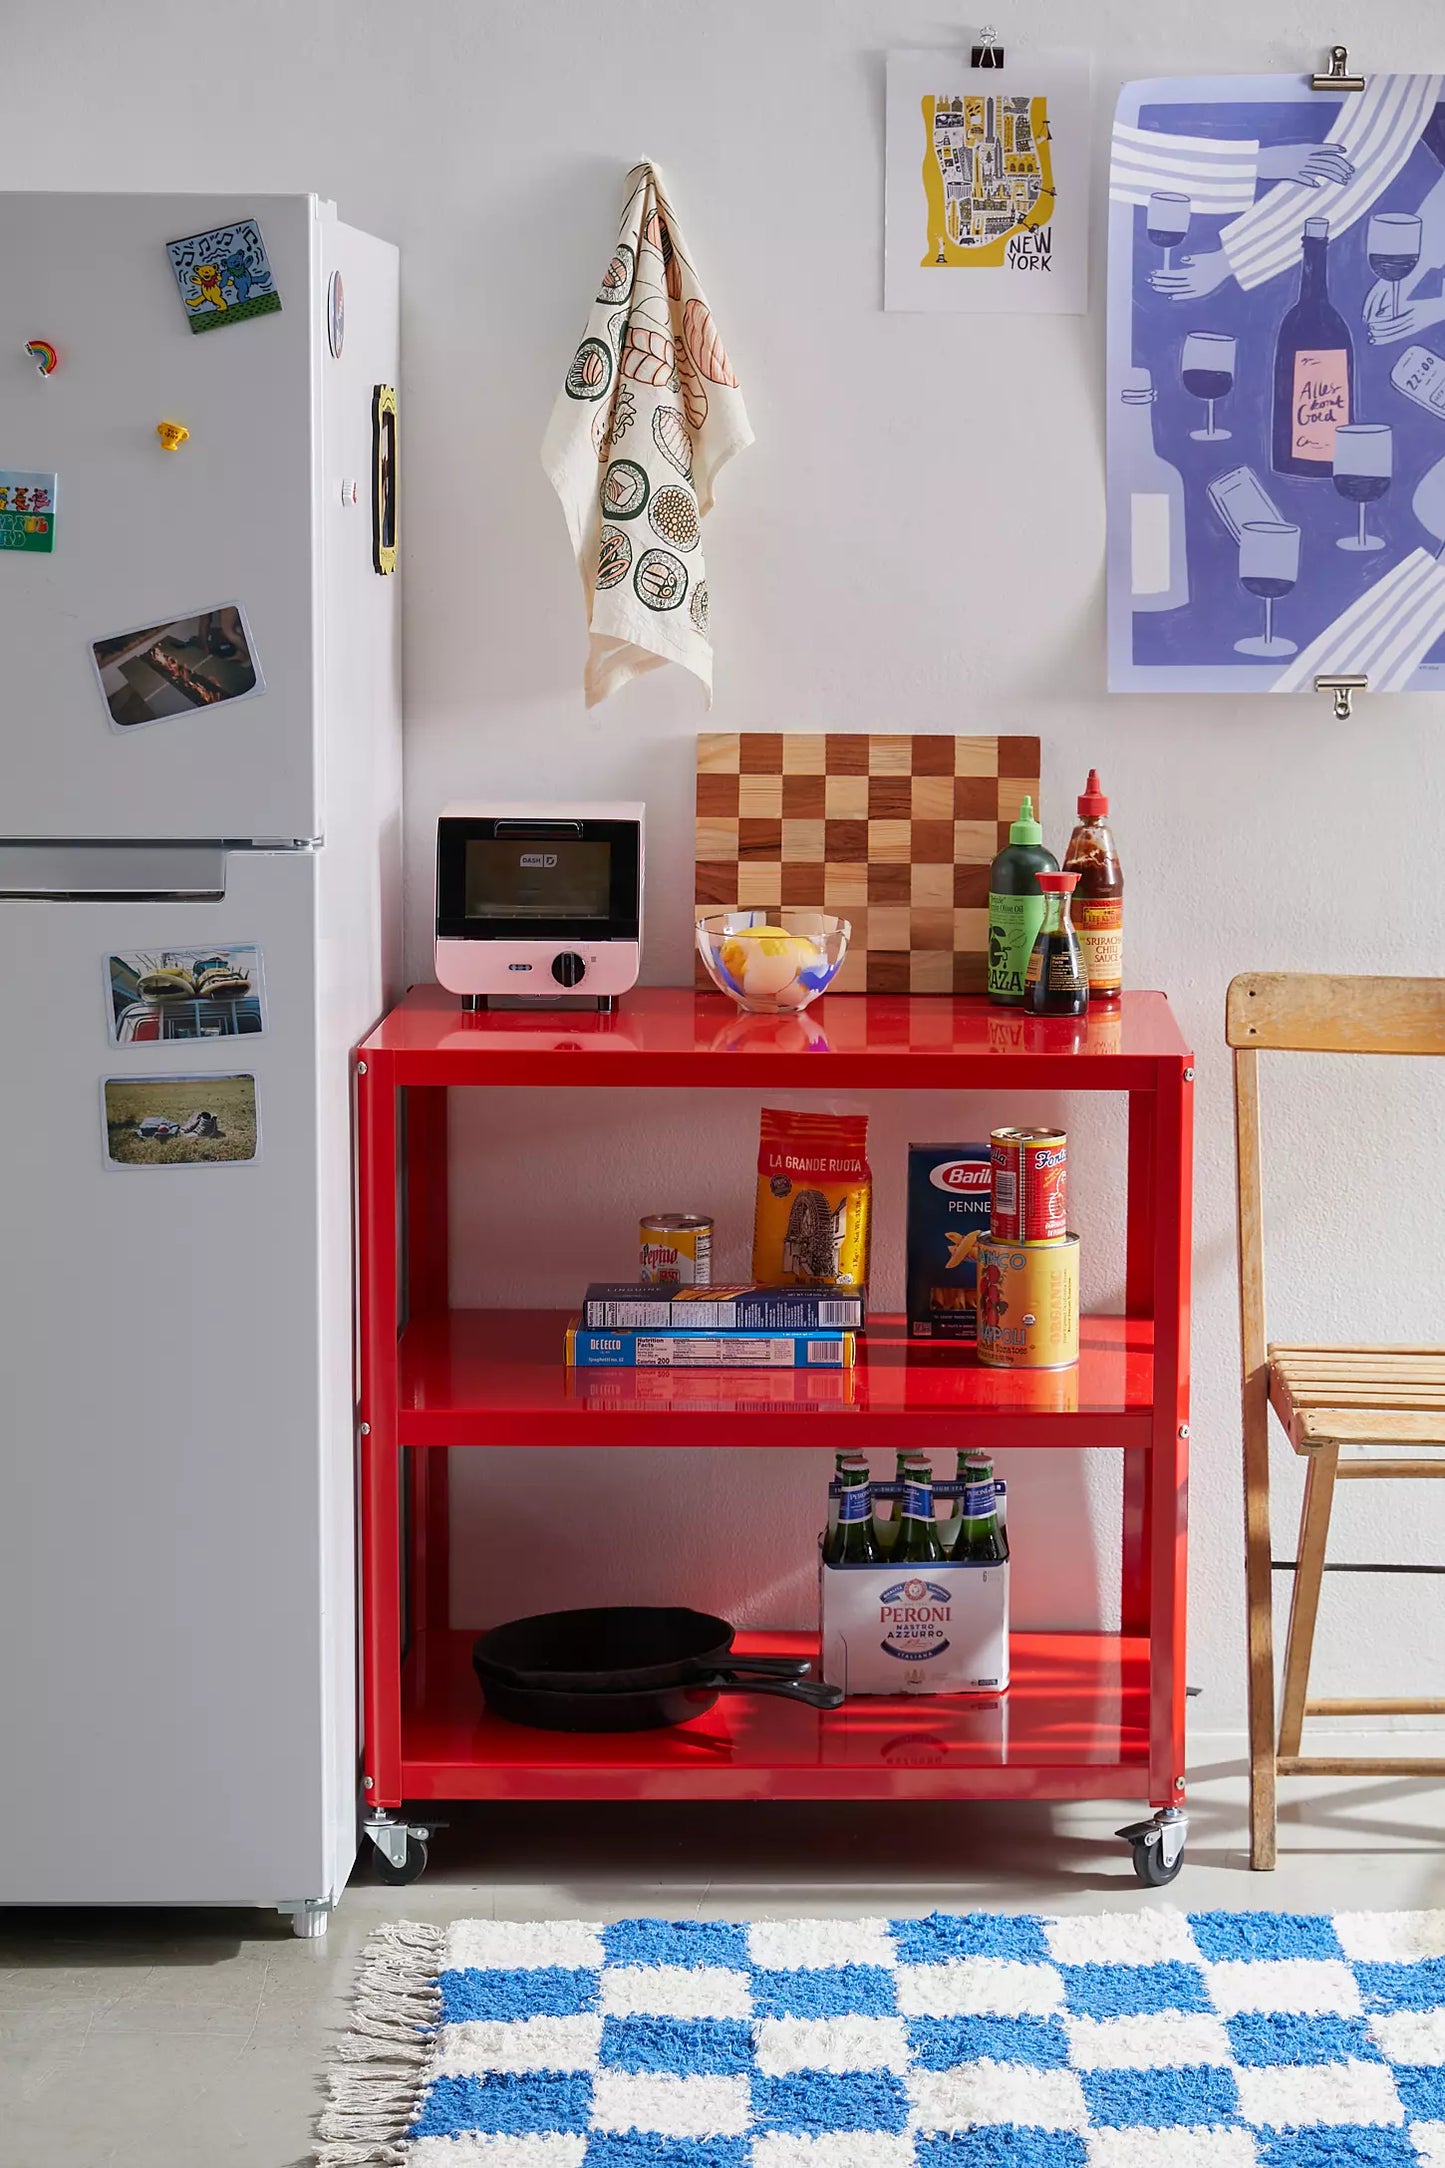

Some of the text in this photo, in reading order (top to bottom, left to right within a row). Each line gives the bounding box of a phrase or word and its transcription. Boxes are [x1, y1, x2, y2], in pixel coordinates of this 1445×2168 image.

[1010, 227, 1051, 254] NEW
[1007, 253, 1052, 271] YORK
[1406, 357, 1434, 391] 22:00
[1094, 954, 1119, 963] SAUCE
[990, 968, 1024, 993] AZA
[769, 1154, 862, 1173] LA GRANDE RUOTA
[948, 1168, 992, 1184] Barill
[948, 1201, 992, 1213] PENNE
[880, 1606, 952, 1623] PERONI
[887, 1630, 943, 1639] AZZURRO
[896, 1623, 934, 1631] NASTRO
